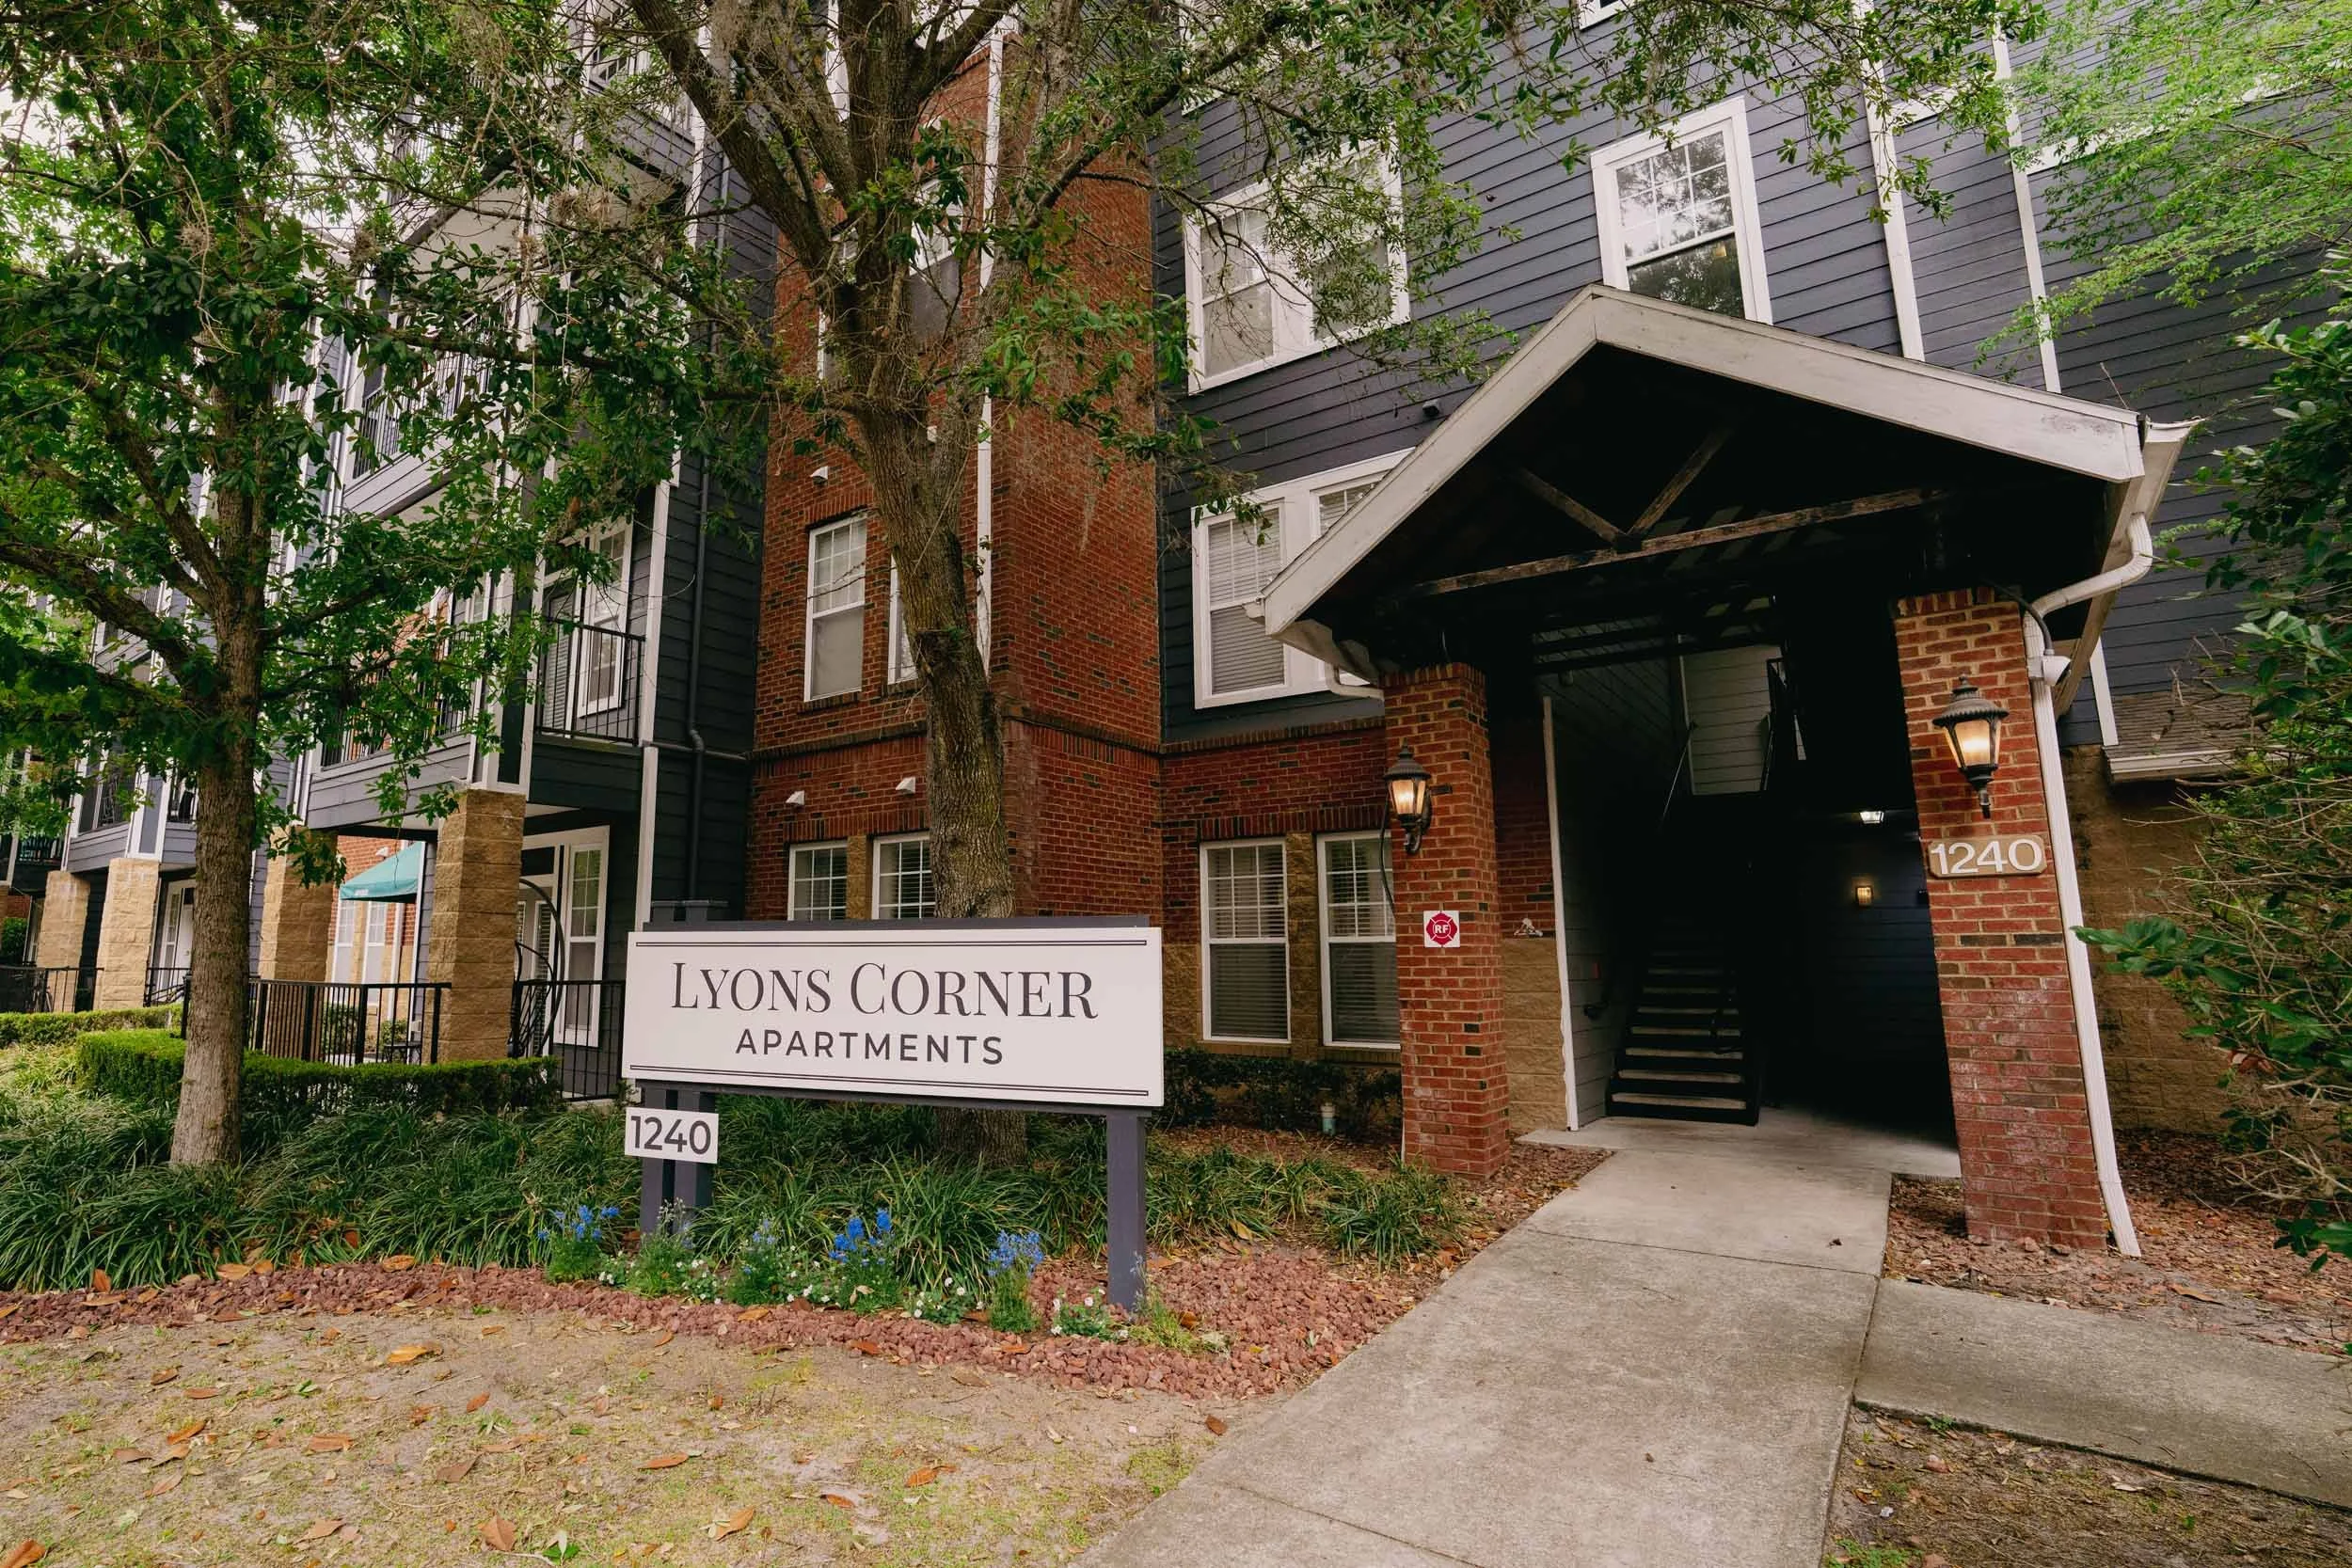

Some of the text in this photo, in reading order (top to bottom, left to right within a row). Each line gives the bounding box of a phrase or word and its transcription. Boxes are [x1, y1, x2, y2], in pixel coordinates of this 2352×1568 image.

[1931, 839, 2042, 875] 1240
[1435, 924, 1449, 934] RF
[671, 962, 1099, 1019] LYONS CORNER
[736, 1028, 1004, 1066] APARTMENTS
[630, 1116, 711, 1155] 1240
